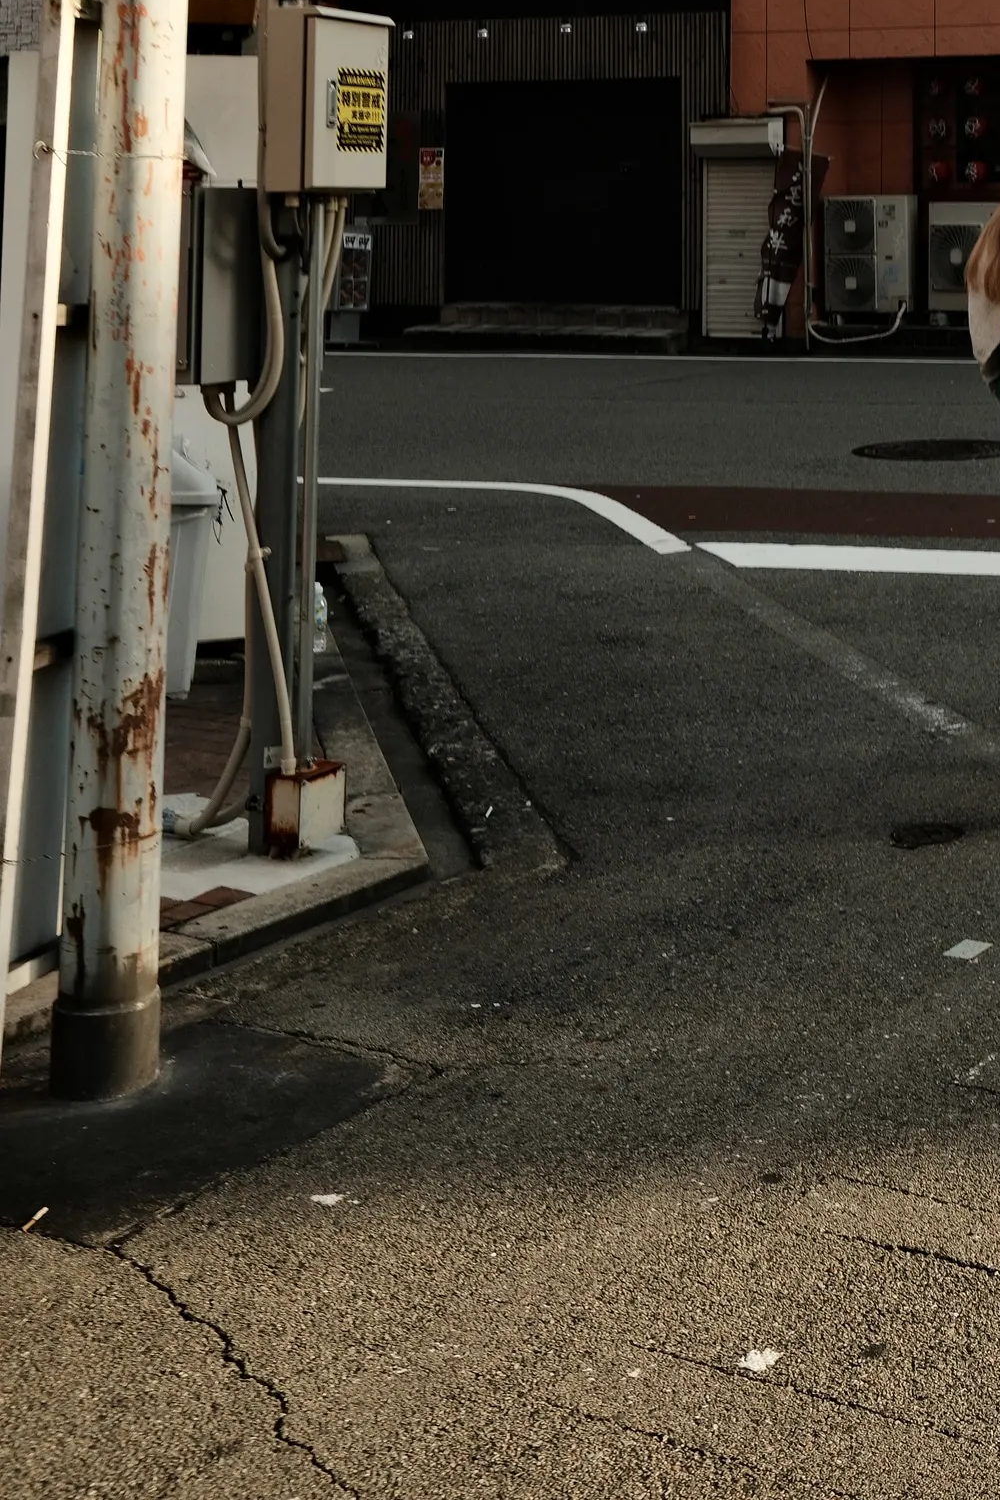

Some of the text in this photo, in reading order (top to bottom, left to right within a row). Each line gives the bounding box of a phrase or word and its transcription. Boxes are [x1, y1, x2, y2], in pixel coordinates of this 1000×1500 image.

[347, 75, 376, 88] WARNING
[341, 91, 381, 109] 特別警戒
